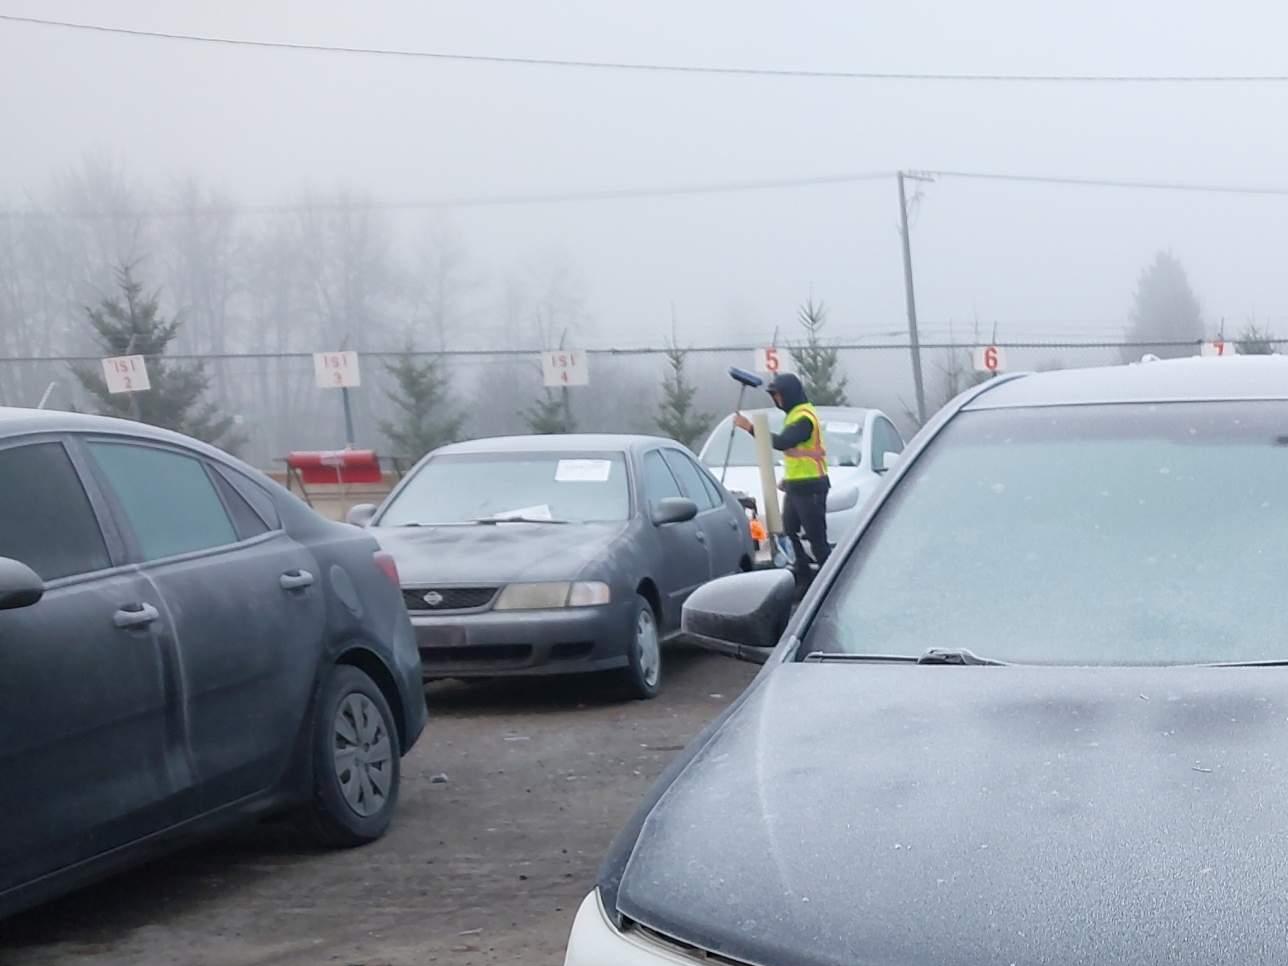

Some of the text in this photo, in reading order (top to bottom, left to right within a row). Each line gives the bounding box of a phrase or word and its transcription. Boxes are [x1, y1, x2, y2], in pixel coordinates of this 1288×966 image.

[1213, 341, 1225, 356] 7
[765, 347, 779, 372] 5
[984, 347, 998, 370] 6
[124, 376, 133, 389] 2
